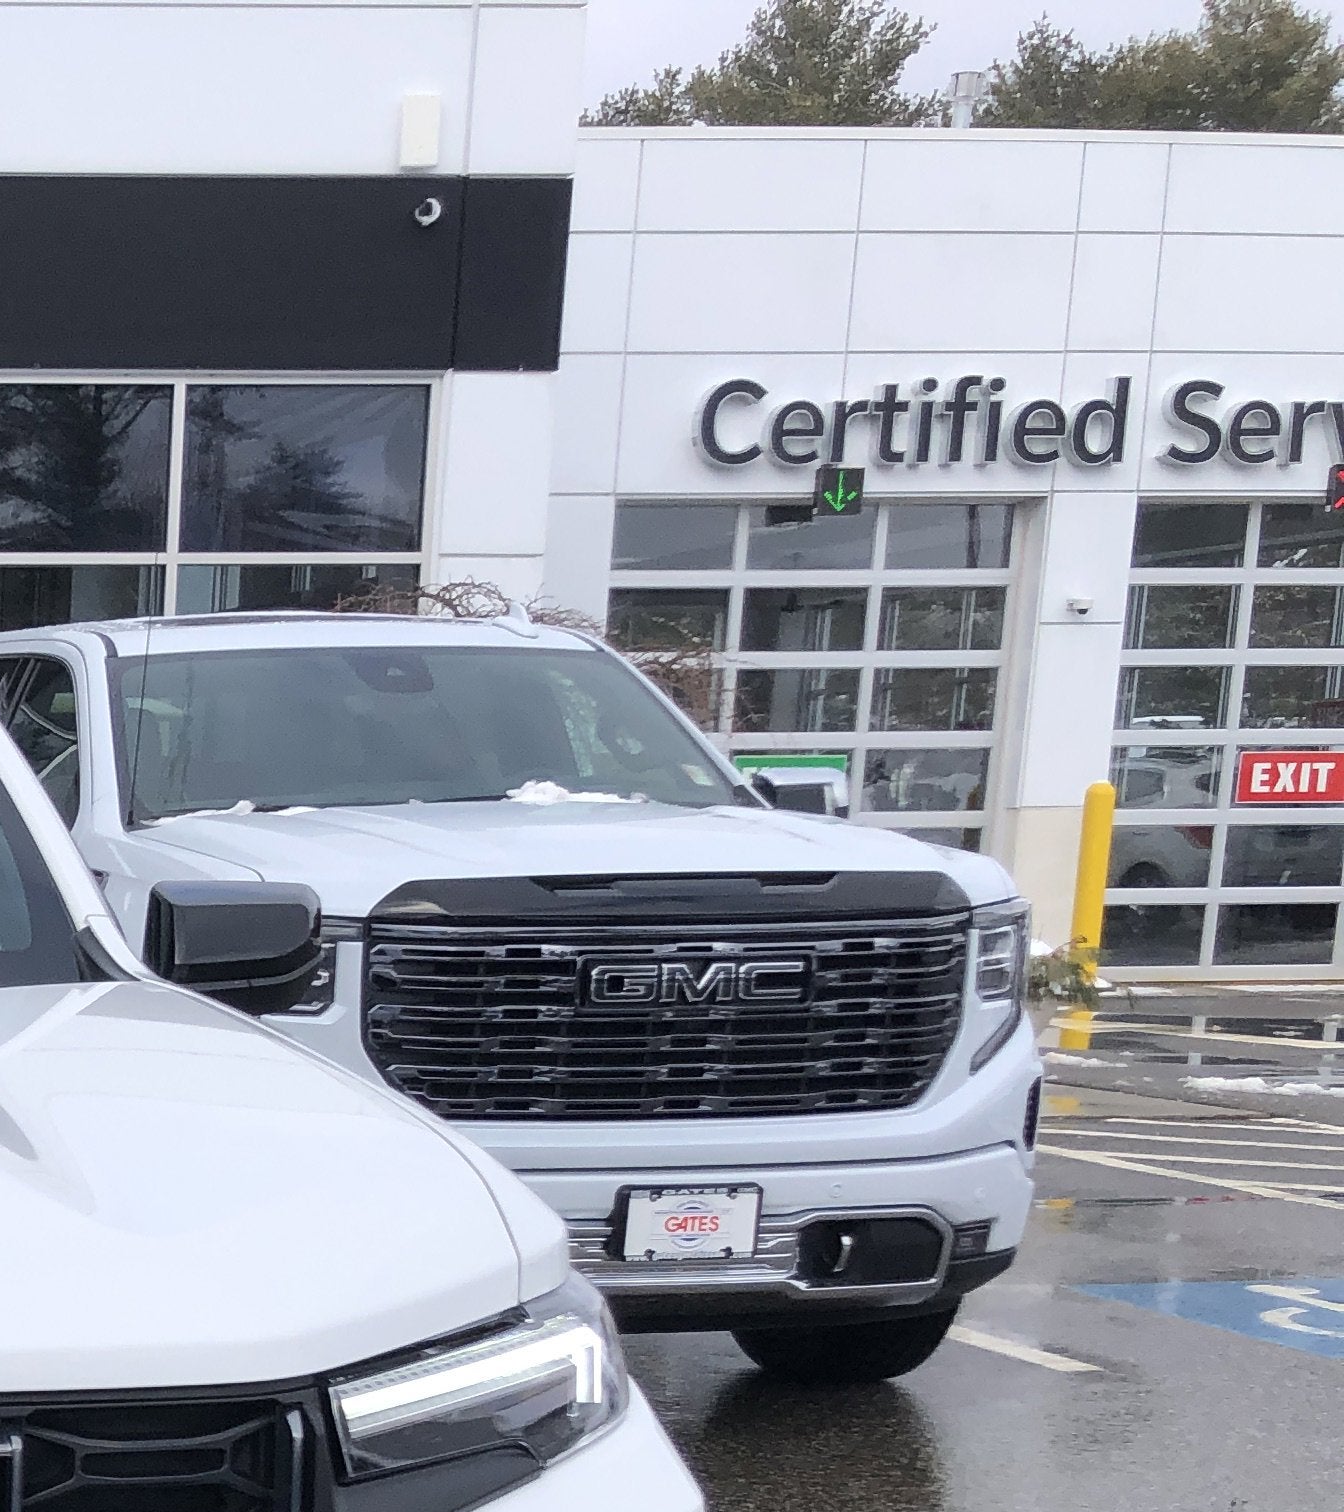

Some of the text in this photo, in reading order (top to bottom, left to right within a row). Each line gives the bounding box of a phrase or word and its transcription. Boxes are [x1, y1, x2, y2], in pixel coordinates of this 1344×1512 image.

[700, 375, 1133, 466] Certified
[1250, 762, 1337, 793] EXIT
[590, 961, 806, 1003] GMC
[664, 1215, 720, 1233] GATES
